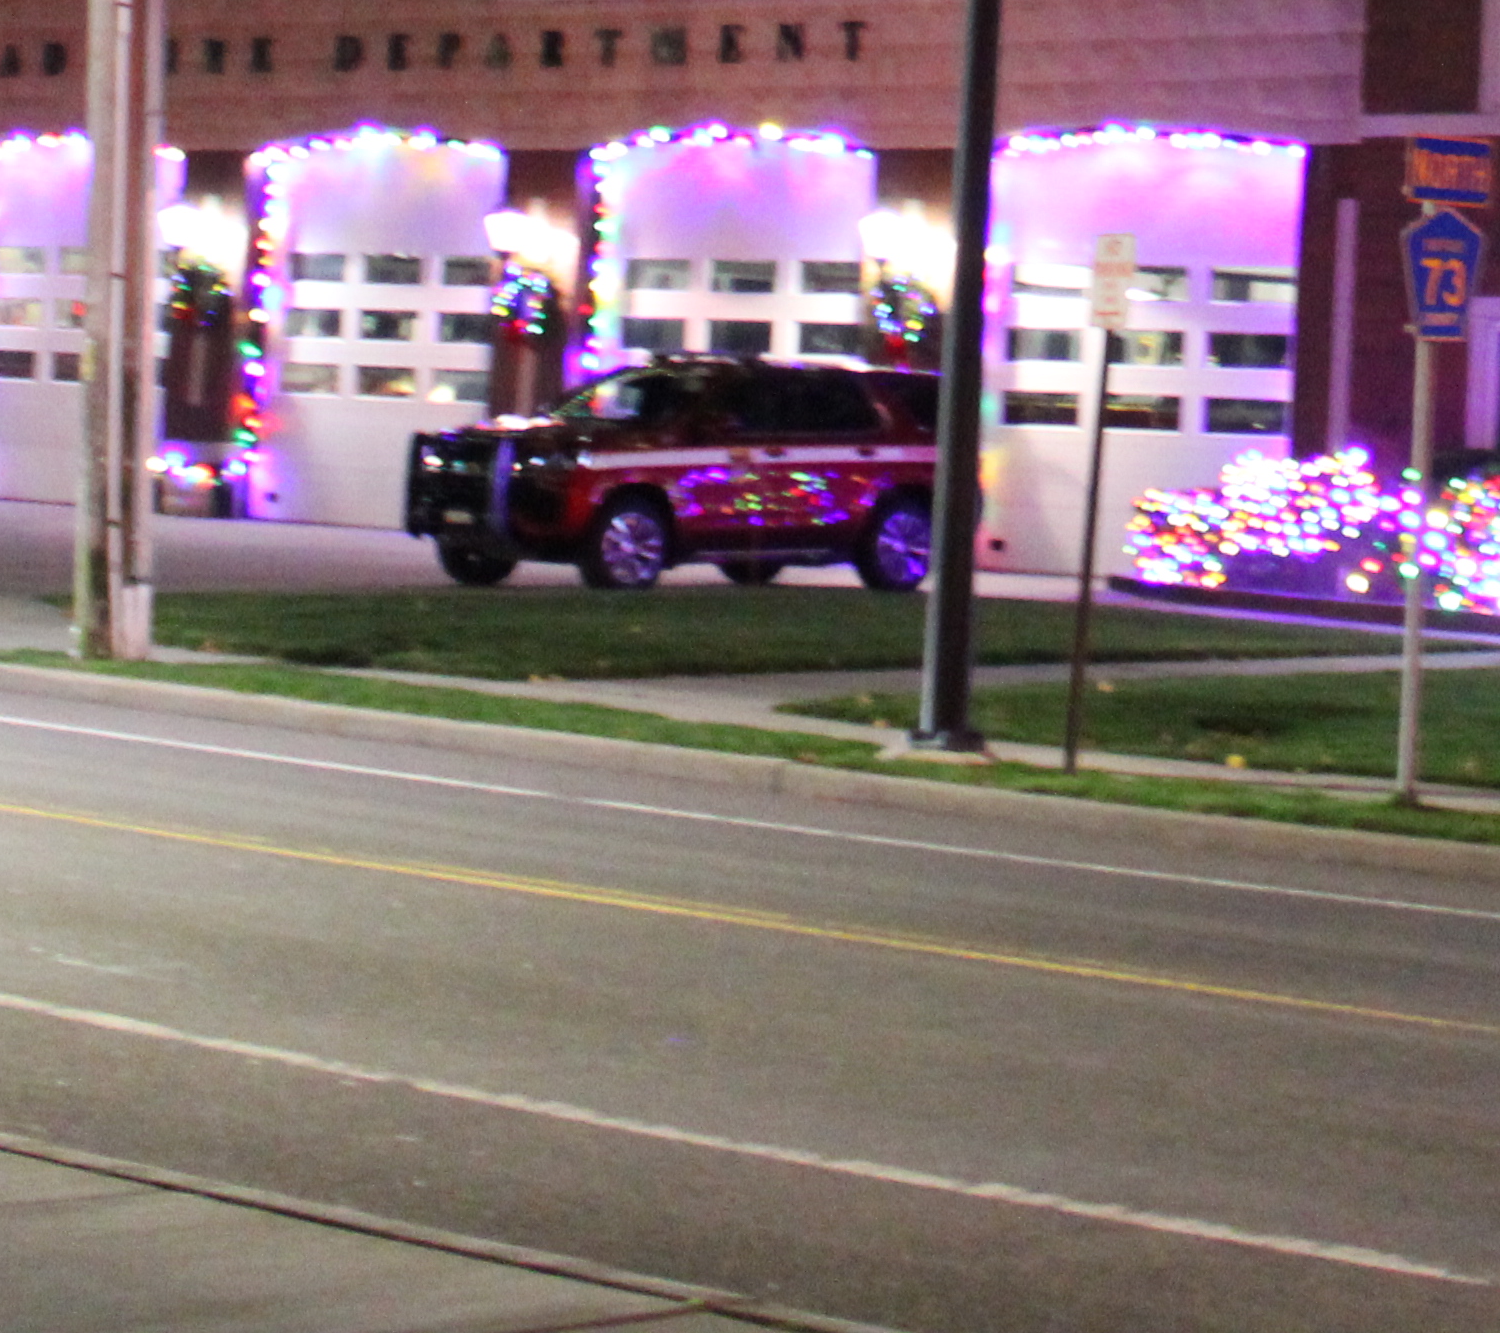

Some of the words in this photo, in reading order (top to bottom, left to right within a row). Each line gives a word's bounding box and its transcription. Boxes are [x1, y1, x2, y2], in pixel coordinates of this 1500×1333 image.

[163, 35, 274, 75] IRE
[332, 20, 870, 73] DEPARTMENT
[1420, 257, 1467, 307] 73
